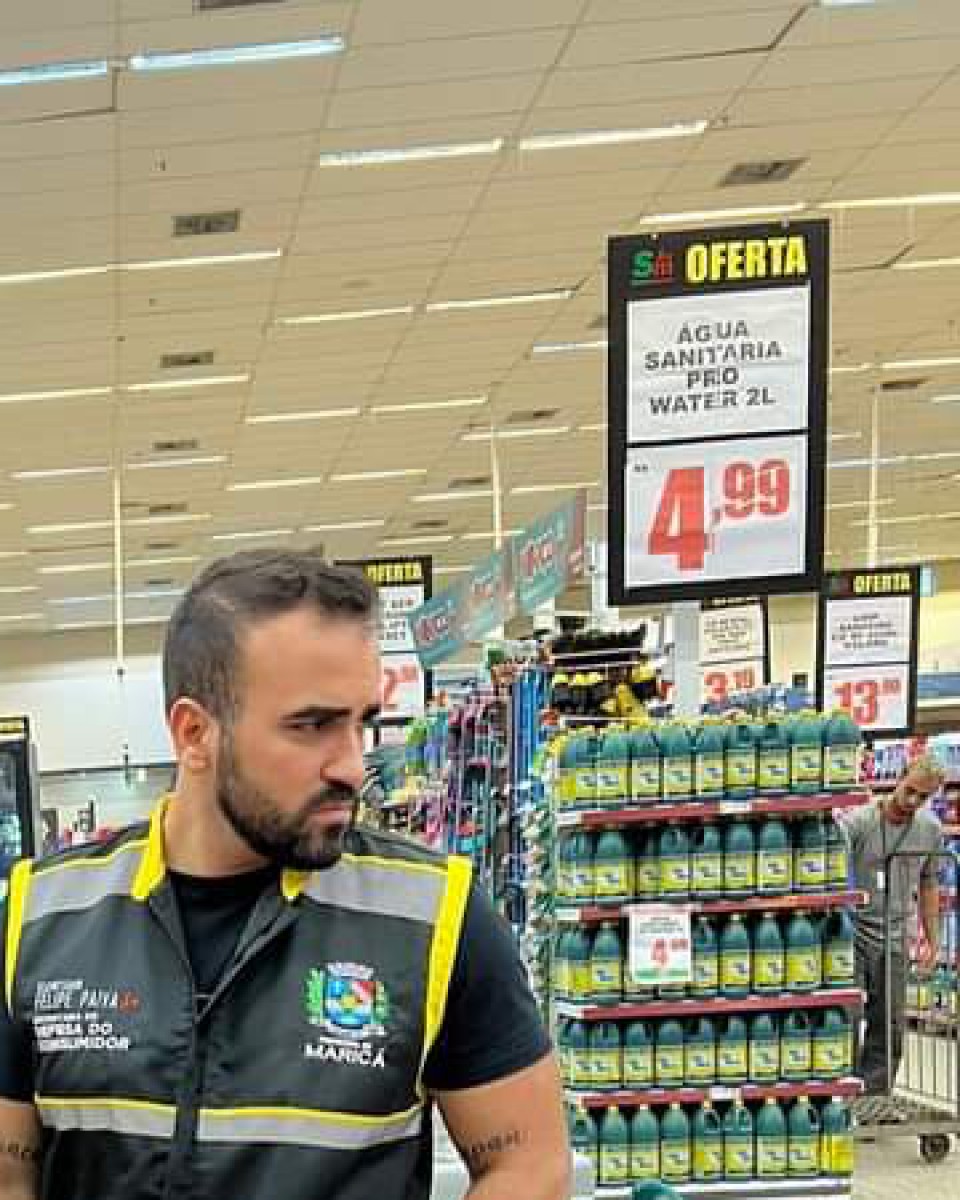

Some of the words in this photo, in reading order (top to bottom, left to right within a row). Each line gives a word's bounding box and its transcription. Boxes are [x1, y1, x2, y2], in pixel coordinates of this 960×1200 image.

[686, 236, 807, 283] OFERTA
[687, 366, 739, 389] PRO
[649, 389, 738, 415] WATER
[746, 387, 777, 407] 2L
[648, 459, 791, 571] 4,99
[852, 573, 911, 593] OFERTA
[87, 1021, 113, 1036] DO
